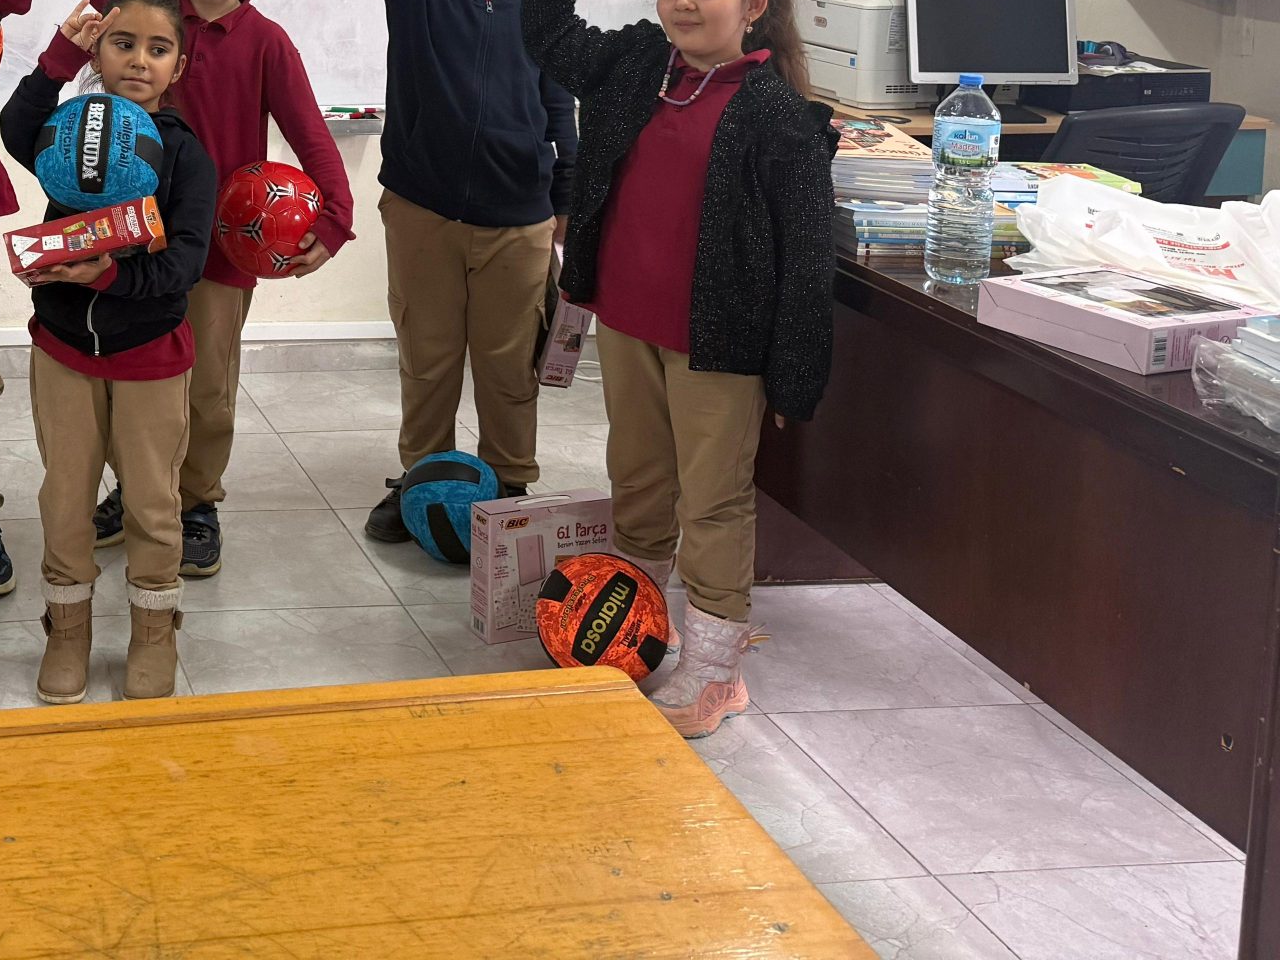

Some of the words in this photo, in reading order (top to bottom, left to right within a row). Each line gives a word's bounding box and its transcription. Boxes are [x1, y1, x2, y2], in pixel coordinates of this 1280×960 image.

[63, 112, 77, 163] OFFICIAL
[81, 102, 106, 180] BERMUDA
[117, 115, 134, 169] volleyball
[557, 526, 569, 539] 61
[575, 523, 607, 538] Parça
[557, 541, 574, 549] Benim
[575, 540, 592, 548] Yazım
[580, 582, 630, 655] miarosa
